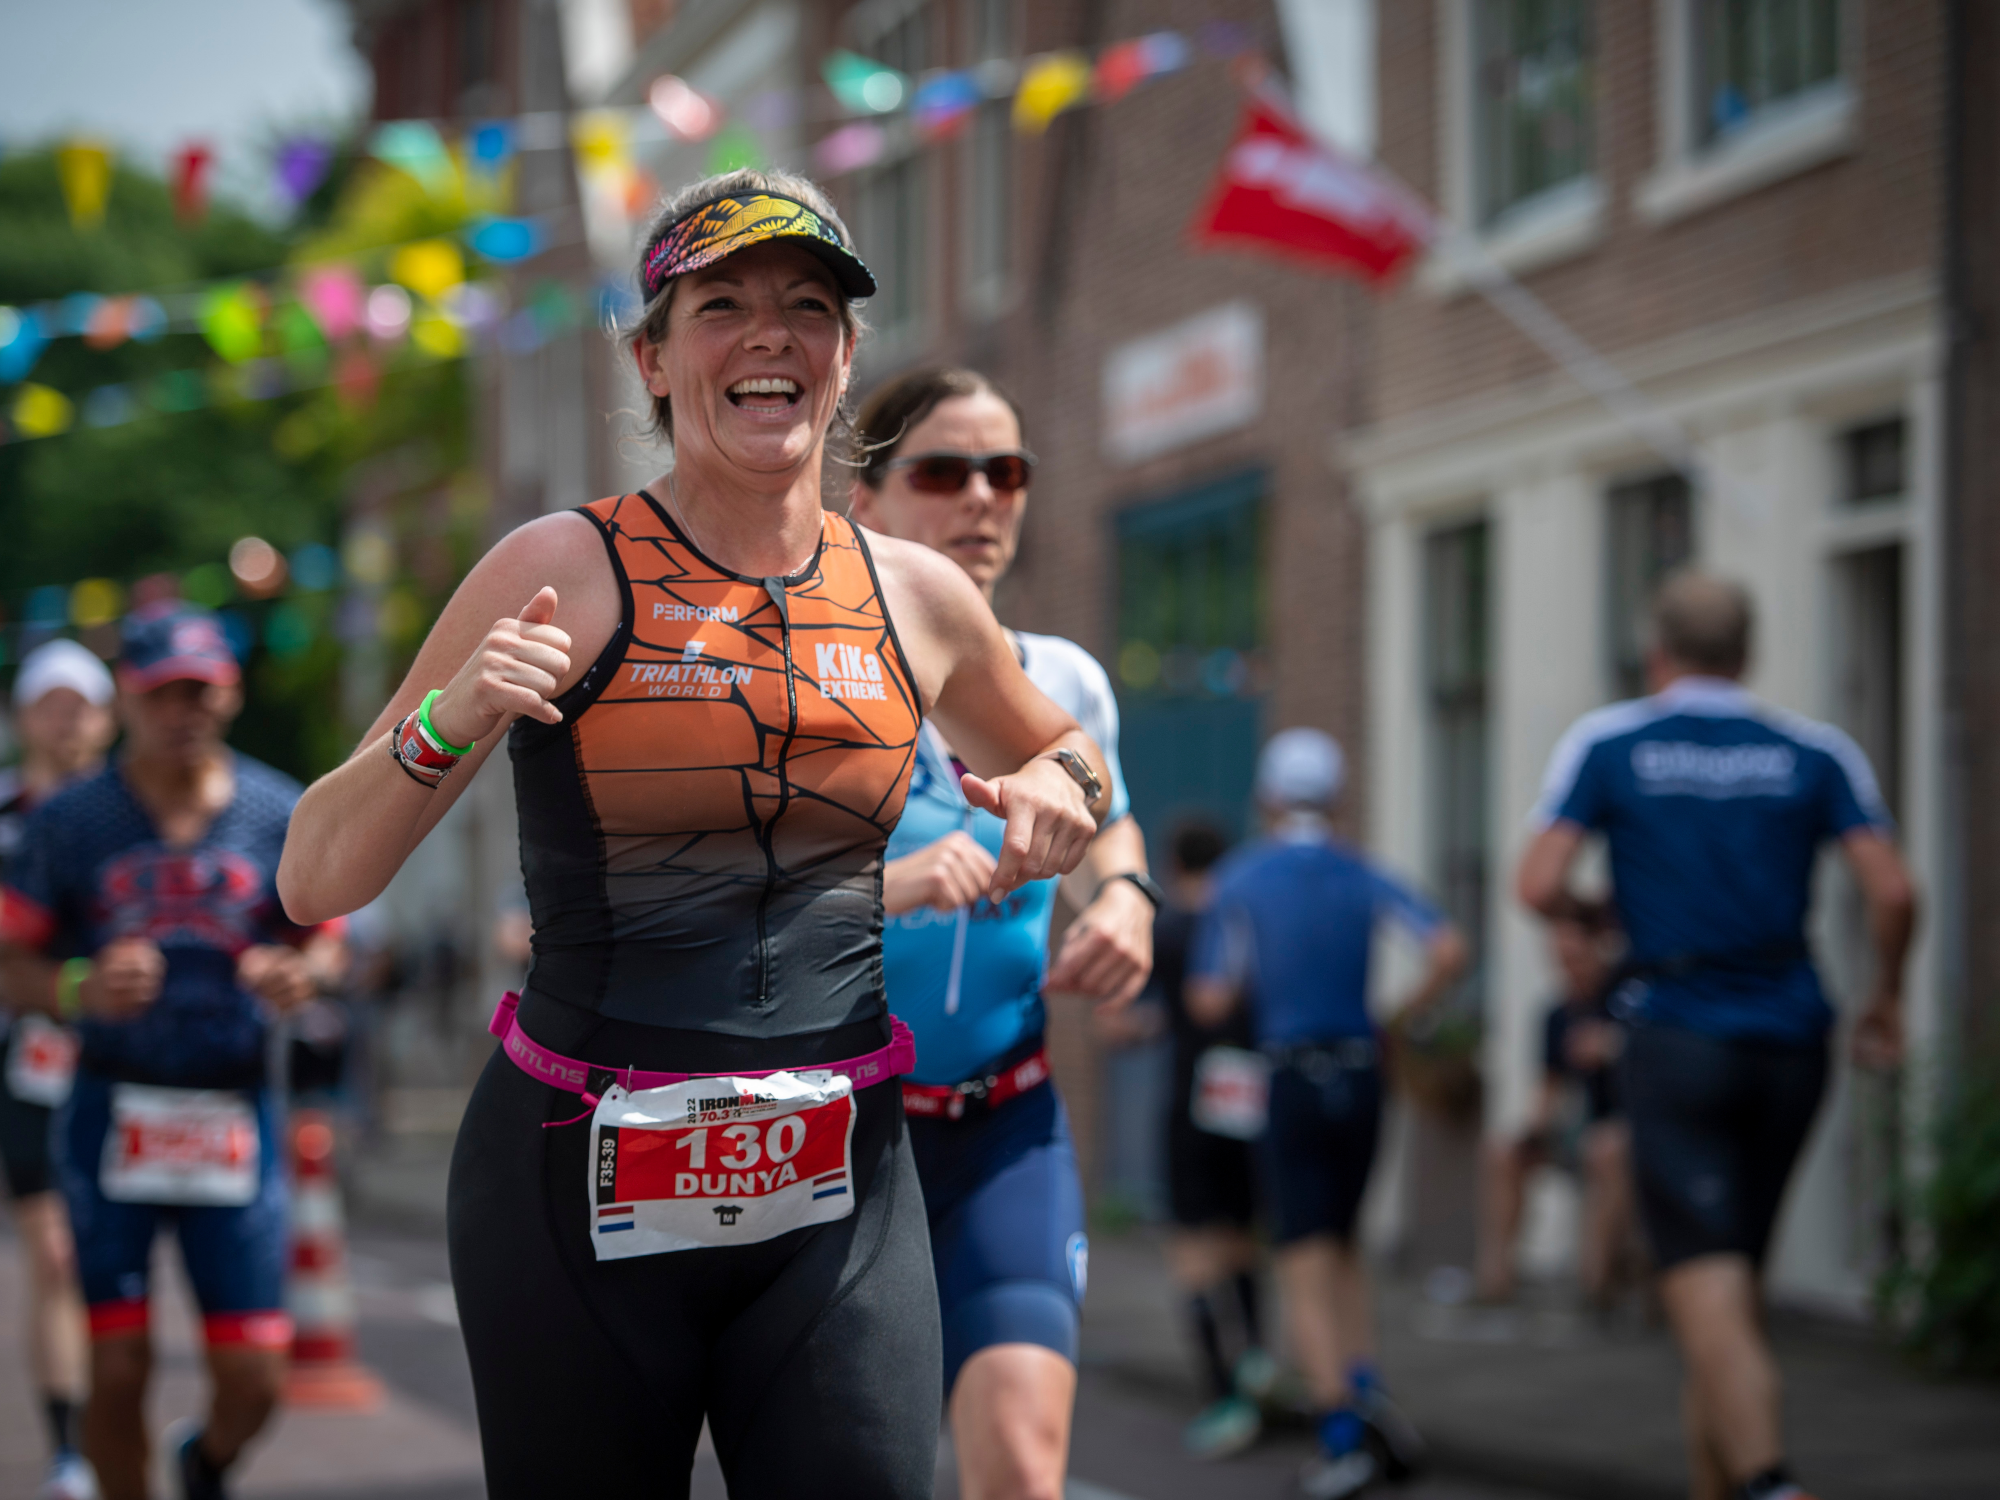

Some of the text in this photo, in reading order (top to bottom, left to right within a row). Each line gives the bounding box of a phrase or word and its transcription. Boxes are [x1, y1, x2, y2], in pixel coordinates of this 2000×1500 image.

[653, 603, 738, 622] PERFORM
[815, 643, 882, 682] KiKa
[630, 664, 753, 685] TRIATHLON
[648, 685, 721, 697] WORLD
[819, 680, 887, 701] EXTREME
[687, 1098, 697, 1124] 2022
[700, 1109, 730, 1123] 70.3
[676, 1115, 806, 1170] 130
[600, 1138, 616, 1187] F35-39
[675, 1161, 798, 1196] DUNYA
[723, 1213, 733, 1223] M
